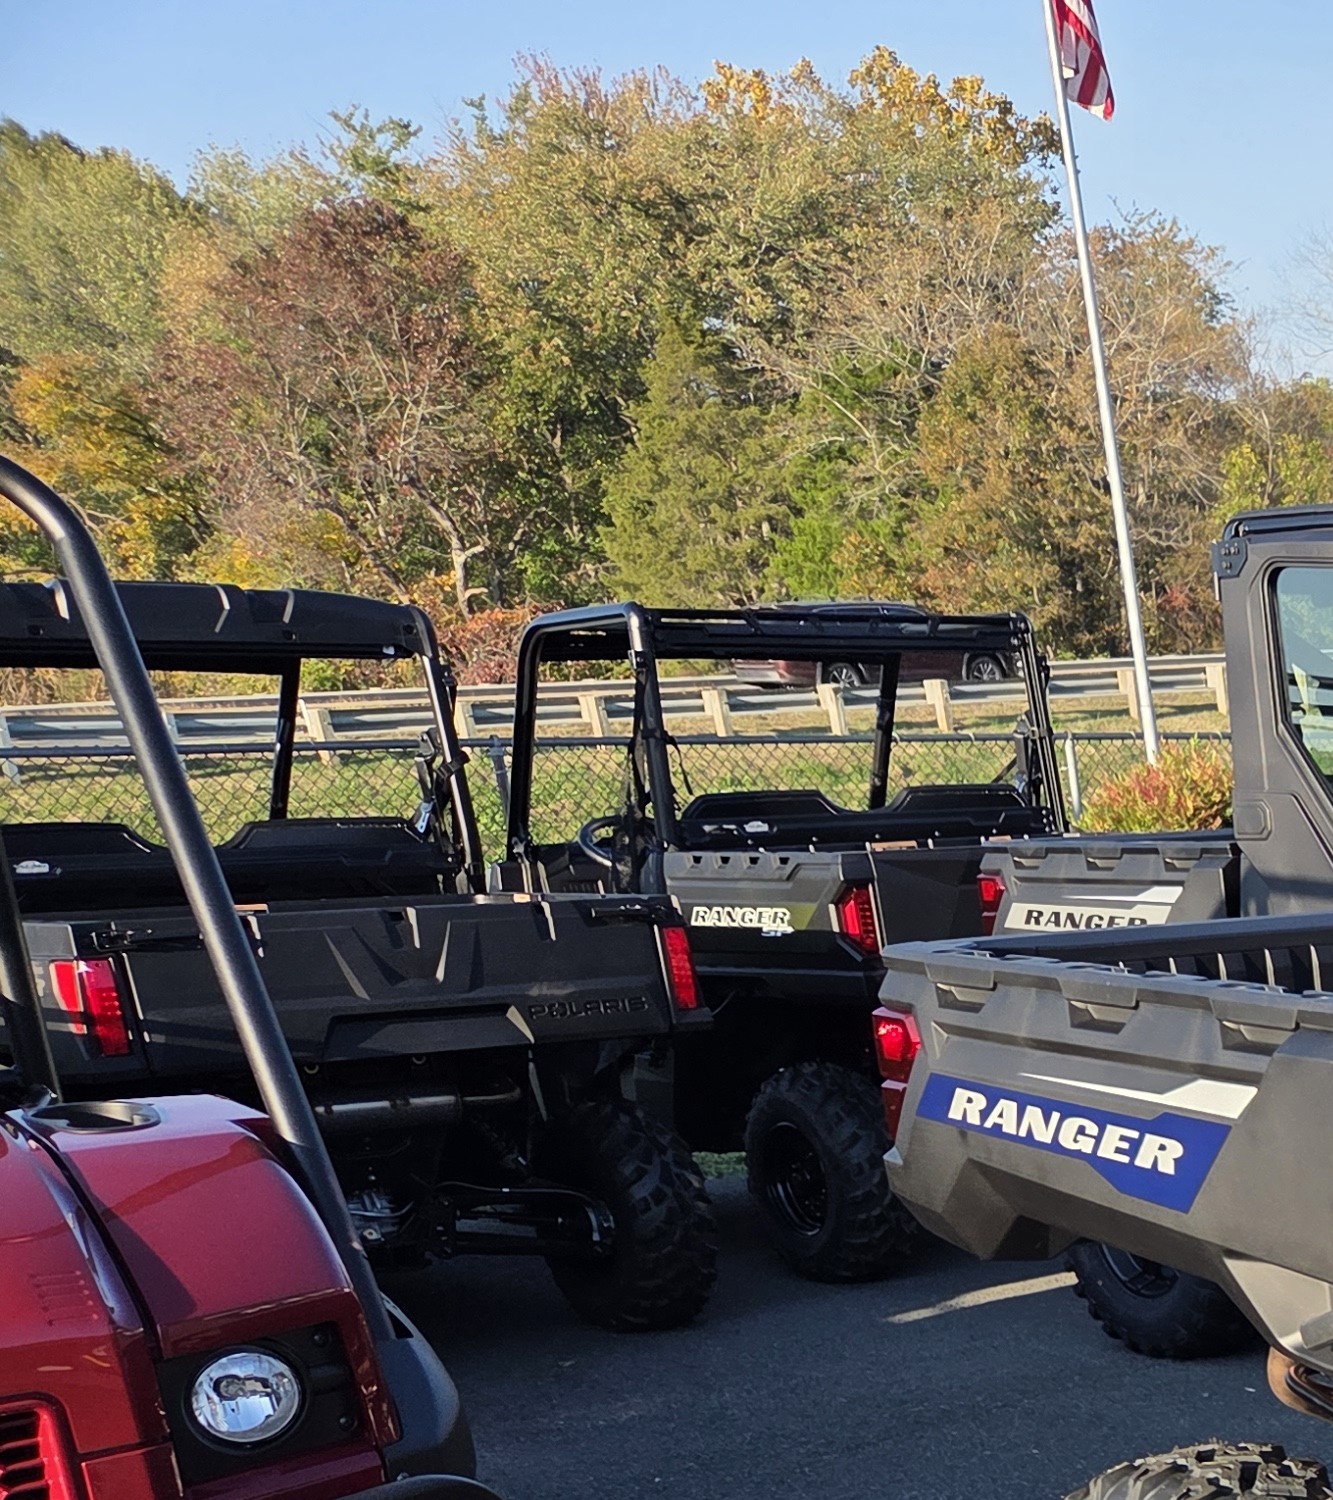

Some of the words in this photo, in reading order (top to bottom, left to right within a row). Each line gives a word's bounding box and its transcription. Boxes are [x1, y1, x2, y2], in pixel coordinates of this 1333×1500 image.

[690, 906, 791, 928] RANGER
[529, 997, 649, 1019] POLARIS
[948, 1087, 1184, 1175] RANGER
